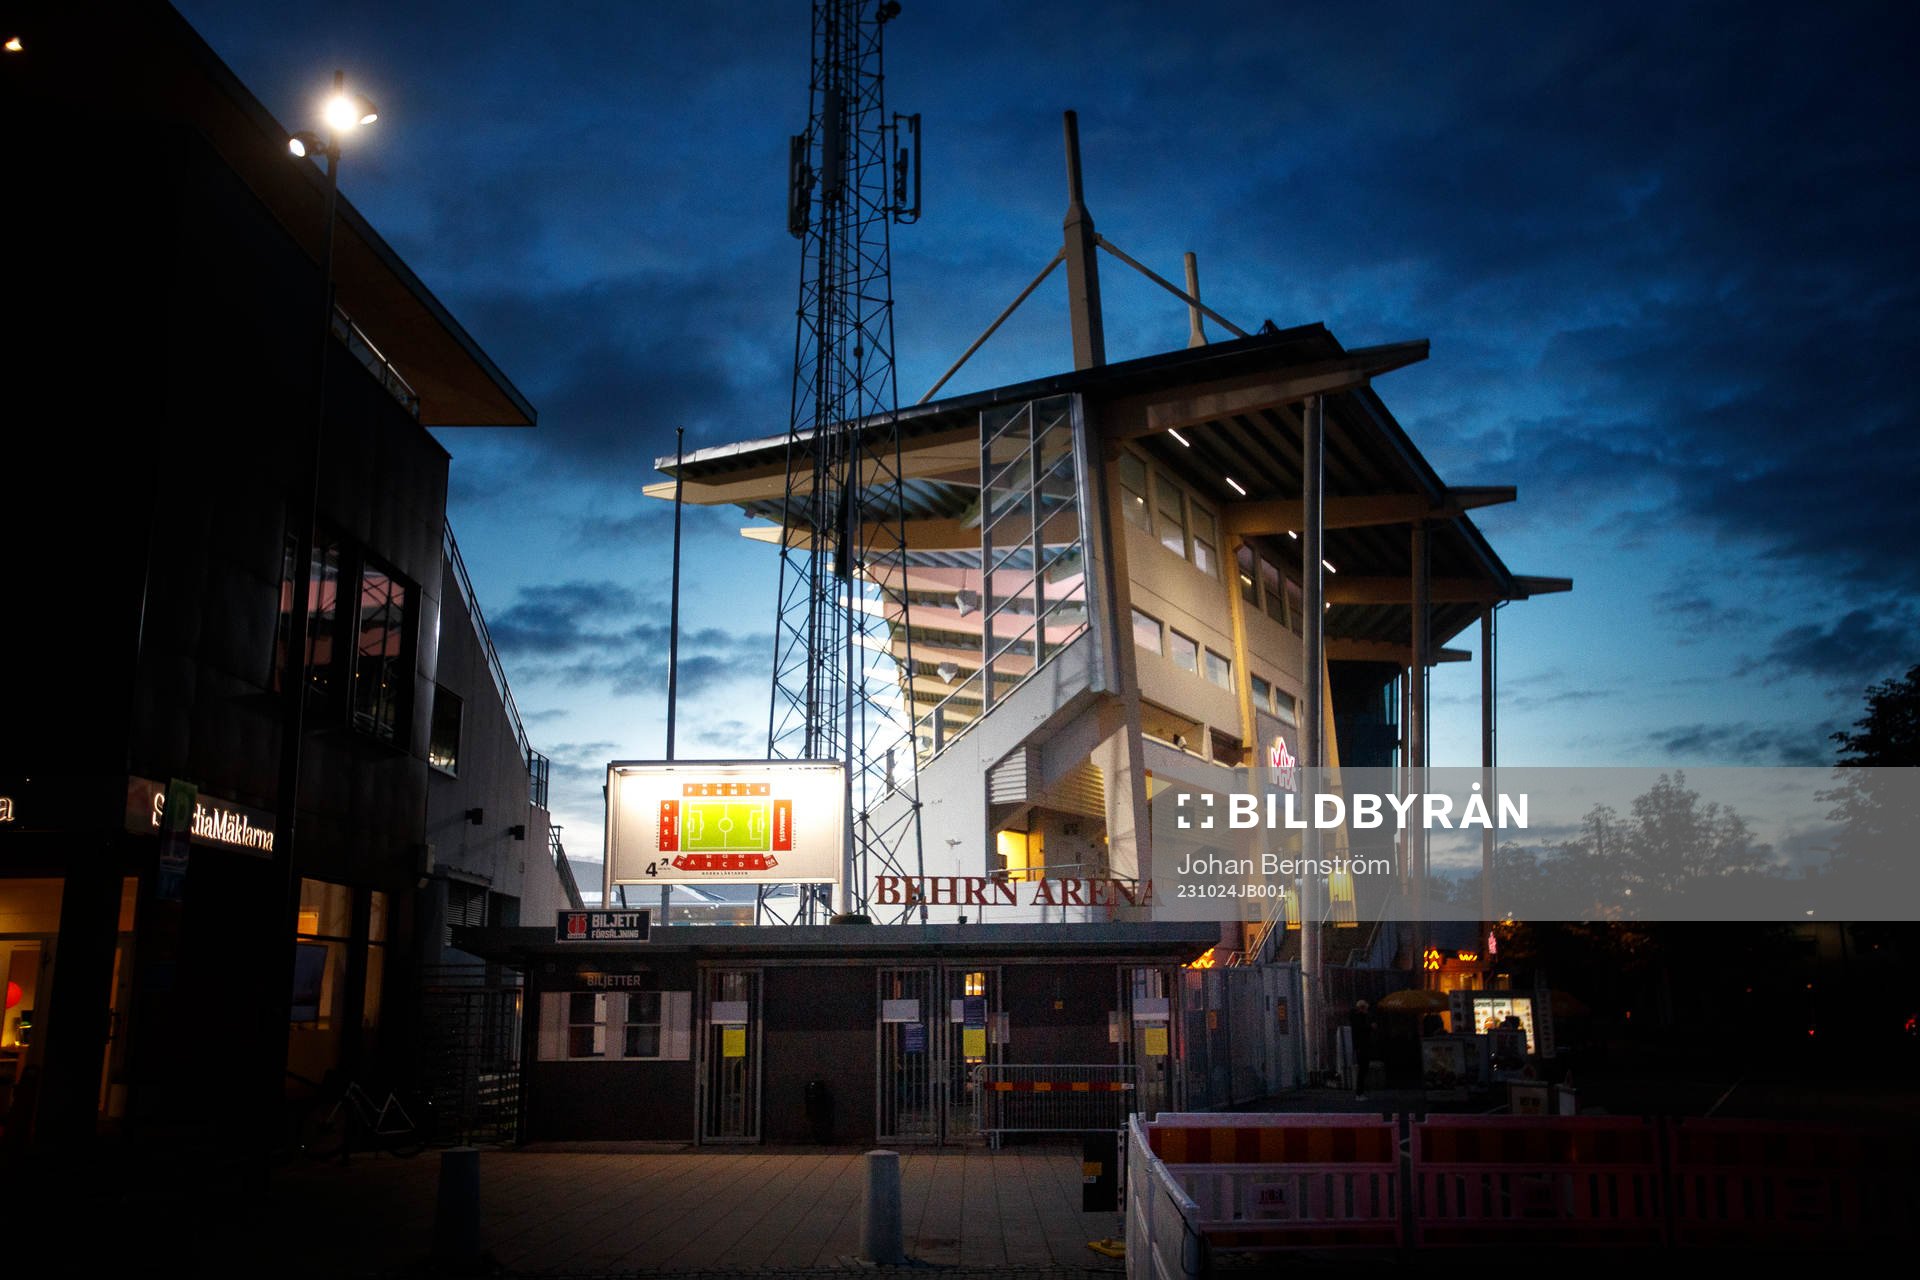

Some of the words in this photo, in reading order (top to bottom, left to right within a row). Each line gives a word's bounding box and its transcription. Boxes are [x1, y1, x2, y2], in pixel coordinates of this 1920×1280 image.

[151, 792, 275, 852] SdiaMäklarna
[646, 862, 658, 876] 4
[875, 875, 1018, 906] BEHRN
[592, 914, 640, 928] BILJETT
[591, 928, 640, 939] FÖRSÄLJNING
[587, 975, 641, 988] BILJETTER
